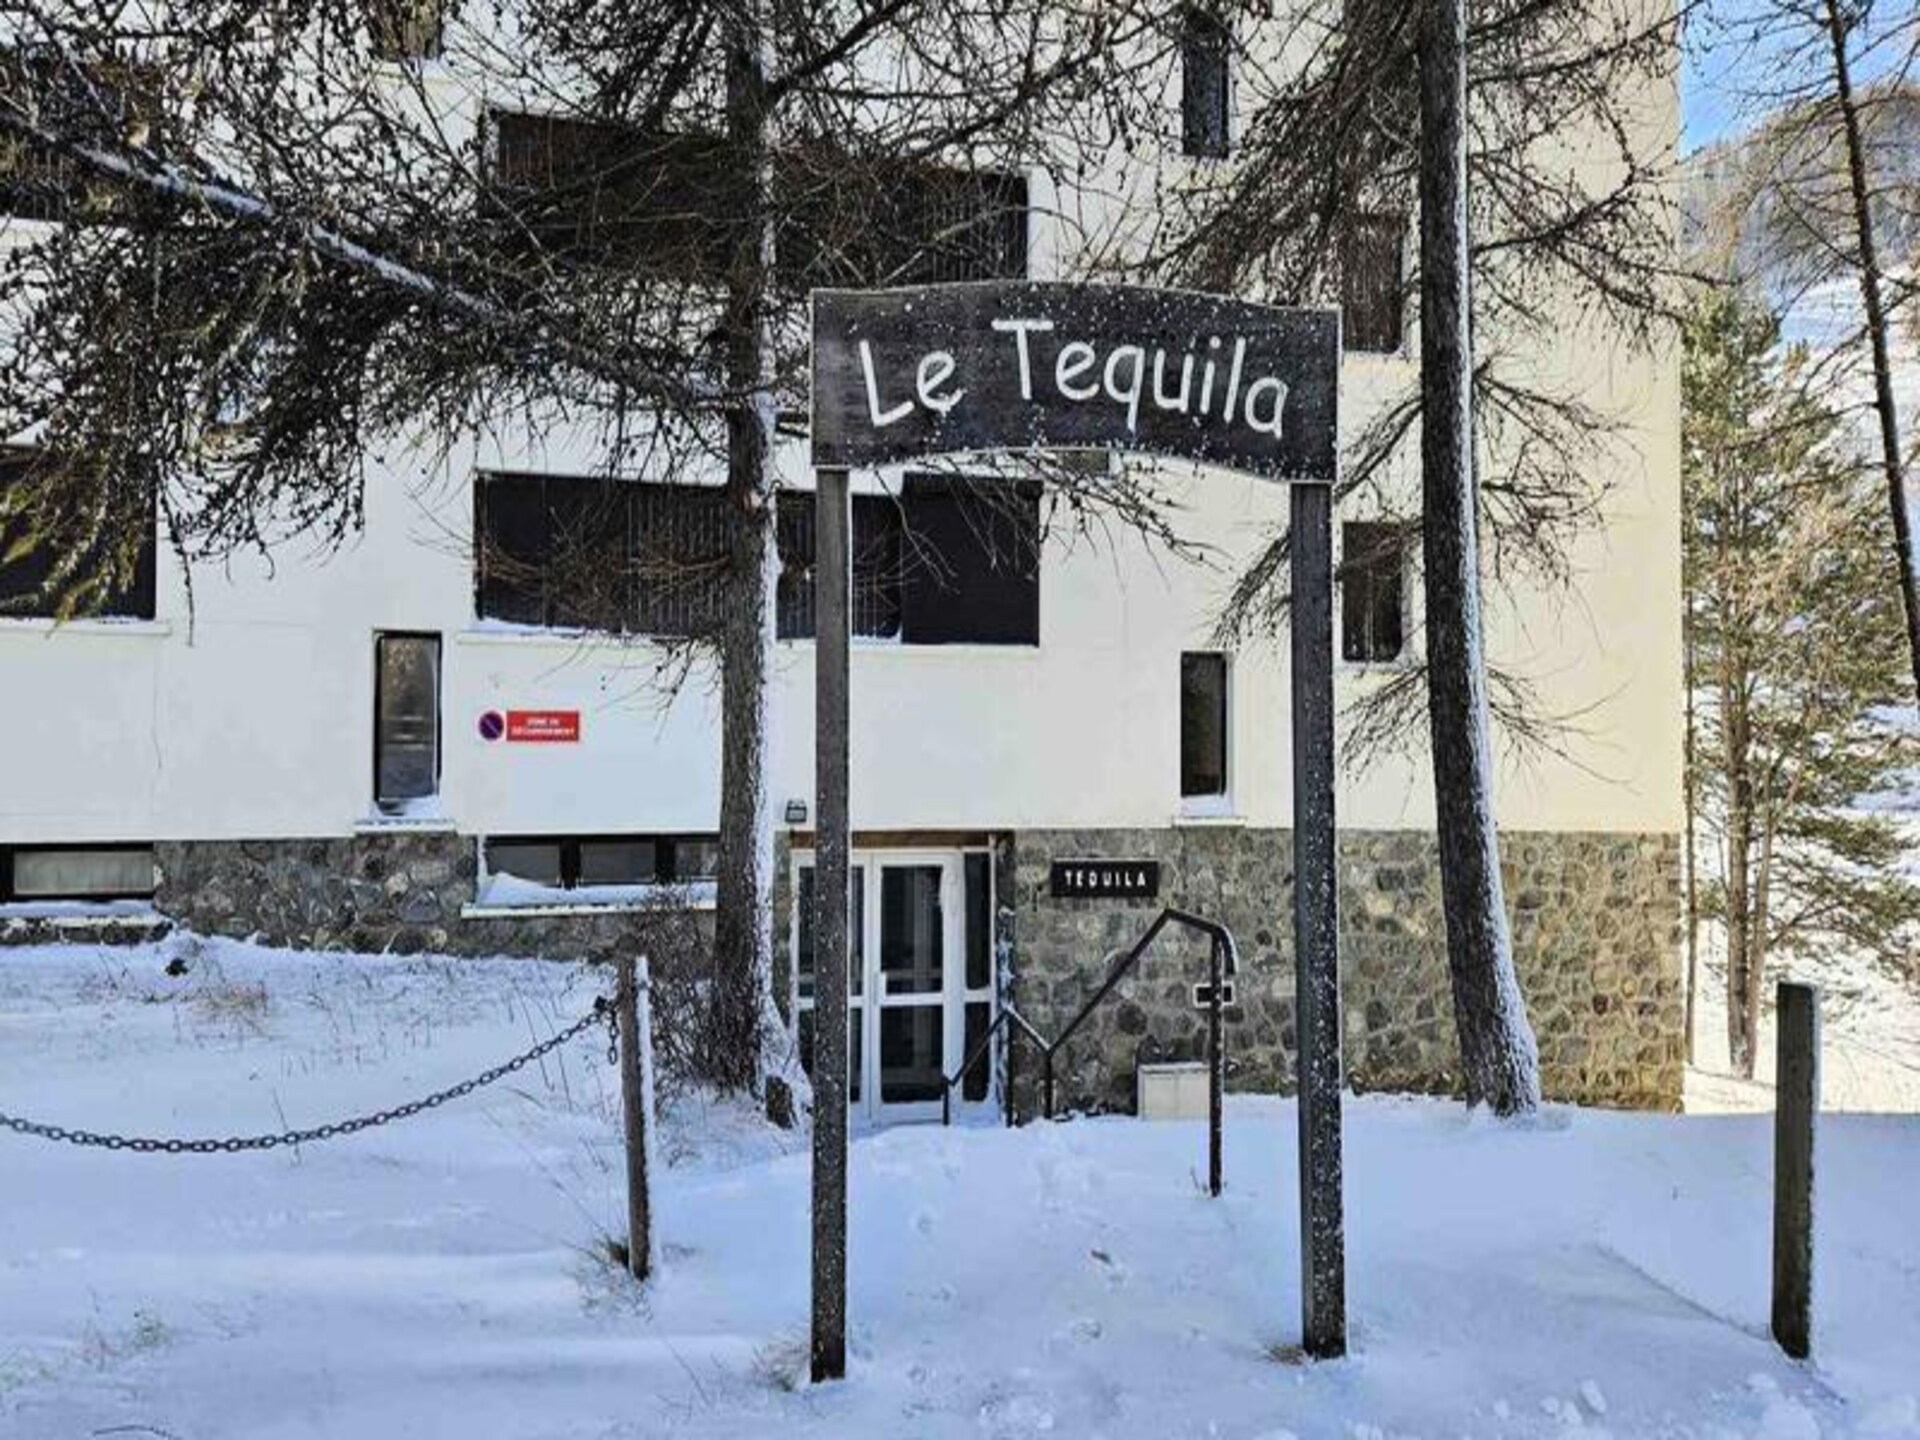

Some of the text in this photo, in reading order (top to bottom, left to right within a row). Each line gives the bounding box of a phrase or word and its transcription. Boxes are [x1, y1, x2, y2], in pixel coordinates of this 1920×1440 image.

[859, 317, 1290, 441] Le Tequila
[1064, 869, 1147, 889] TEQUILA
